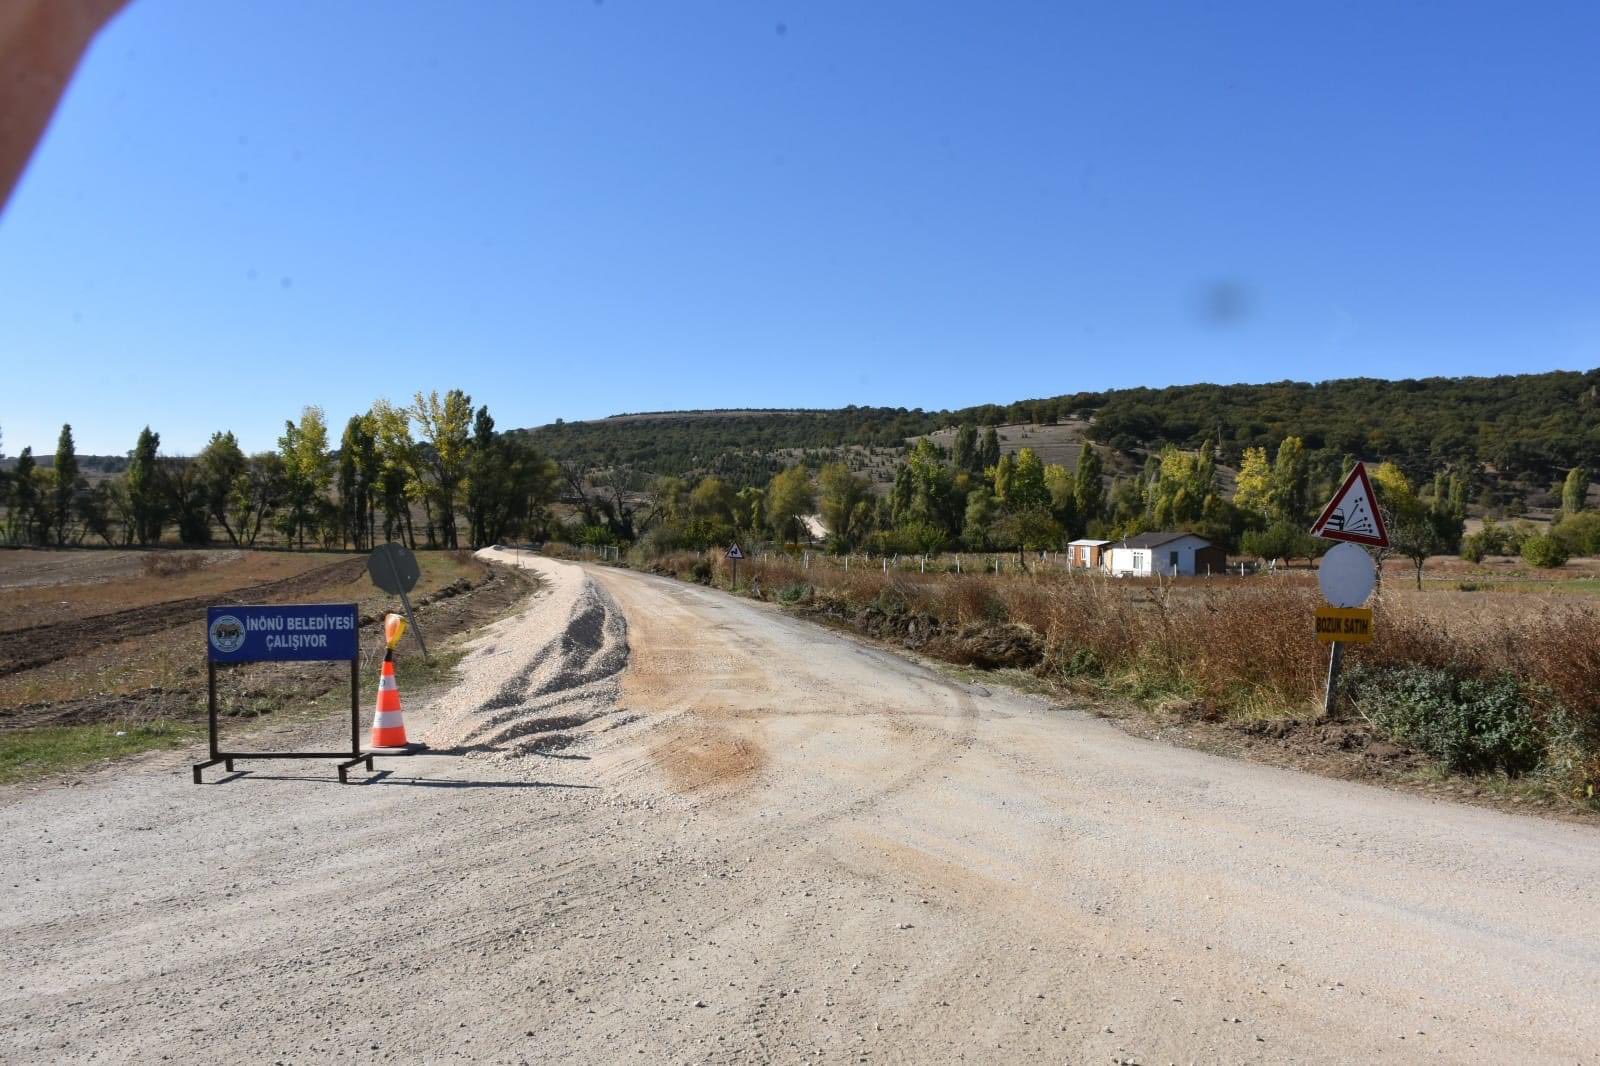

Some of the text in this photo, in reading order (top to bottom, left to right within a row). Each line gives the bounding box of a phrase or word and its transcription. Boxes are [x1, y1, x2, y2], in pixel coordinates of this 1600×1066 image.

[246, 614, 354, 631] İNÖNÜ BELEDİYESİ
[1316, 616, 1368, 634] BOZUK SATIH
[266, 634, 326, 650] ÇALIŞIYOR
